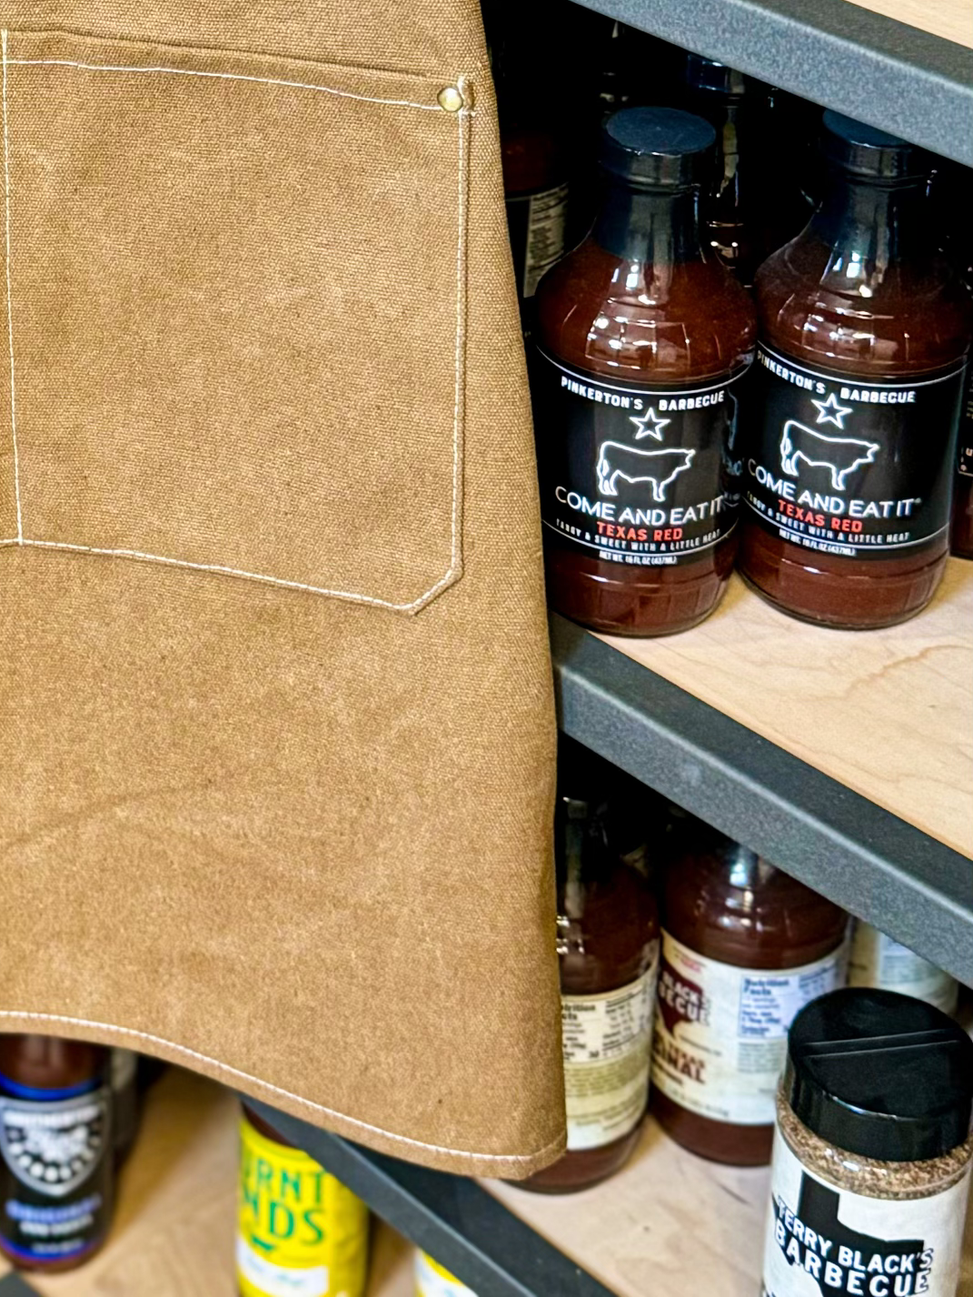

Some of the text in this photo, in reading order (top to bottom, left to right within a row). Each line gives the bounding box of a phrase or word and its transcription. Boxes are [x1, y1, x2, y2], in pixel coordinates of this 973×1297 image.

[561, 376, 725, 411] PINKERTON'S BARBECUE
[757, 349, 916, 404] PINKERTON'S BARBECUE
[555, 486, 617, 522] COME
[619, 508, 666, 527] AND
[669, 503, 709, 525] EAT
[747, 457, 796, 501] COME
[798, 490, 845, 515] AND
[848, 499, 894, 518] EAT
[596, 521, 683, 542] TEXAS RED
[775, 512, 805, 532] SWEET
[808, 525, 834, 540] WITH
[837, 532, 845, 541] A
[847, 532, 883, 544] LITTLE
[886, 531, 910, 542] HEAT
[778, 498, 863, 533] TEXAS RED
[594, 534, 627, 550] SWEET
[631, 541, 656, 551] WITH
[659, 543, 667, 551] A
[669, 538, 700, 551] LITTLE
[702, 529, 721, 543] HEAT
[777, 1195, 934, 1274] TERRY BLACK'S
[774, 1219, 931, 1297] BARBECUE
